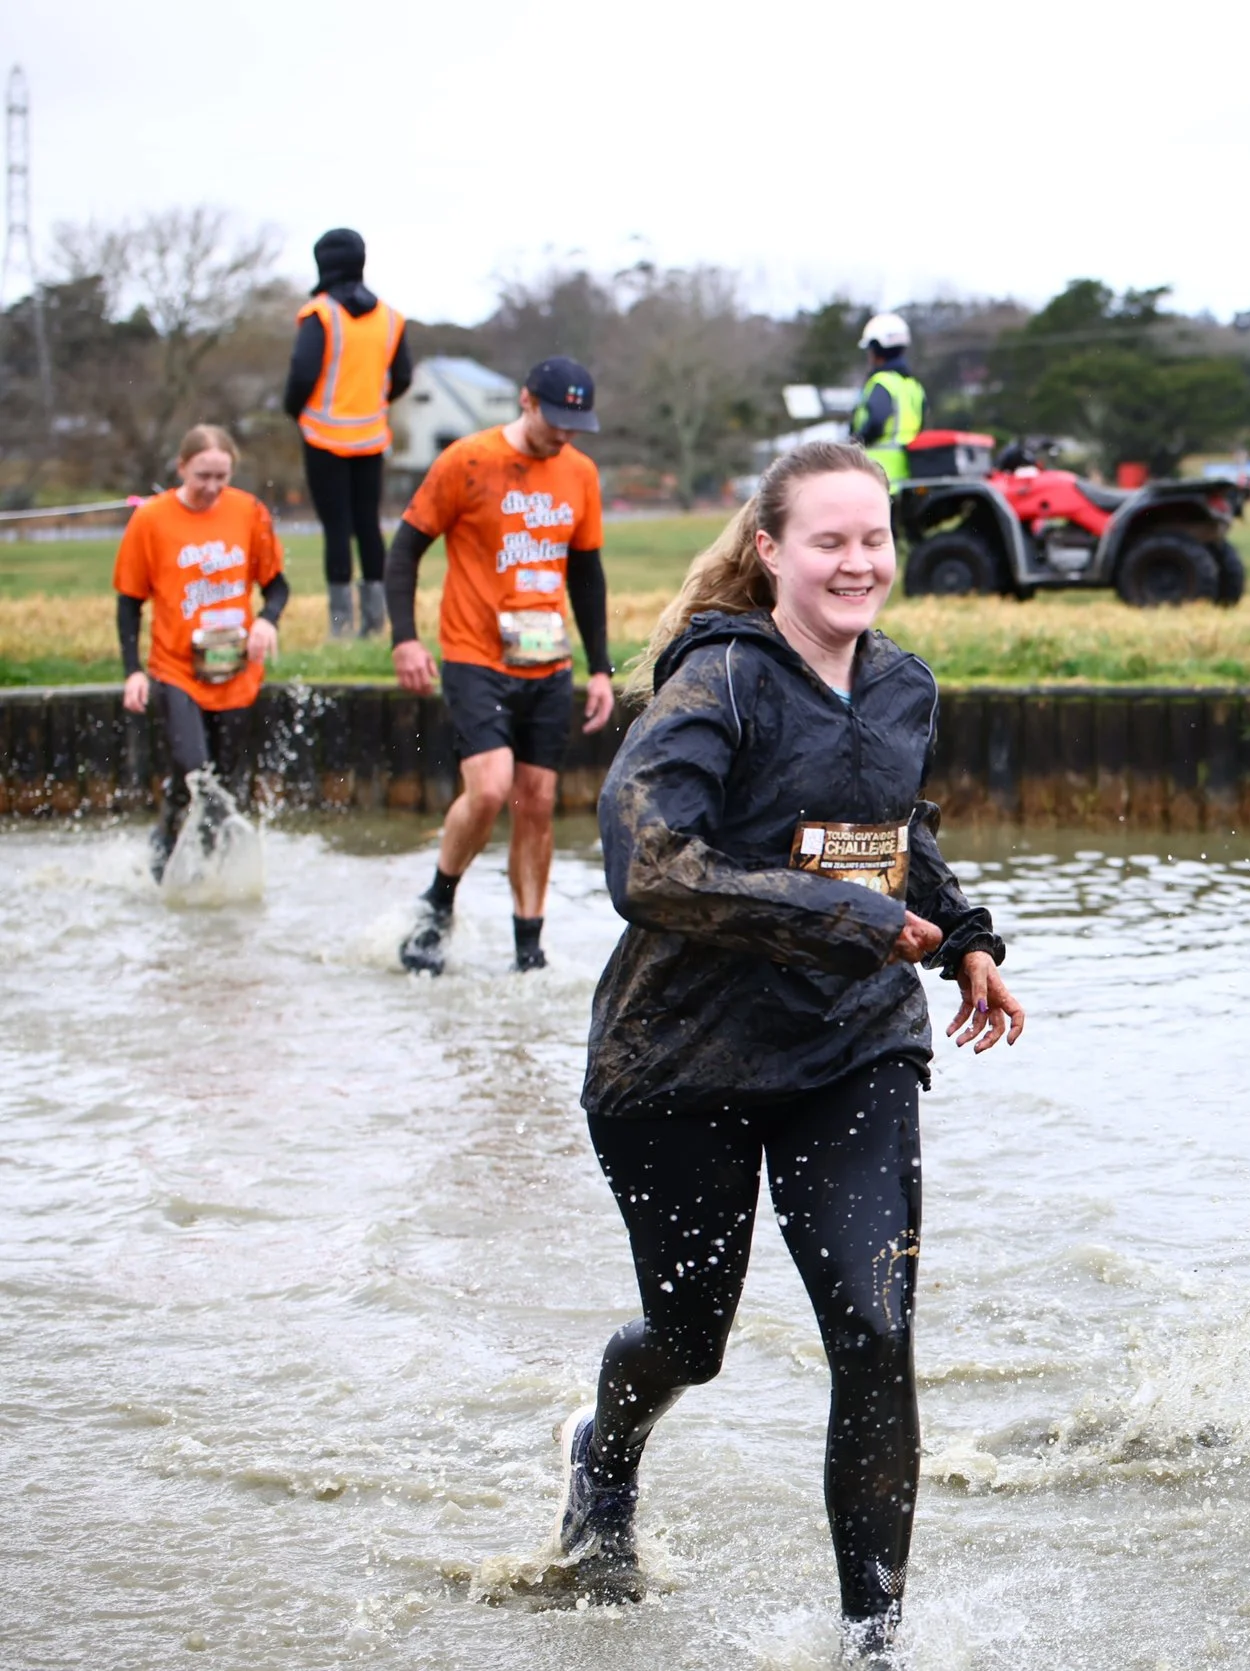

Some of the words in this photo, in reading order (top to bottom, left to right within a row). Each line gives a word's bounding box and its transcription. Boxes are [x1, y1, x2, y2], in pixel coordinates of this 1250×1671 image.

[827, 831, 854, 841] TOUGH
[854, 831, 873, 841] GUY
[825, 840, 895, 855] CHALLENGE
